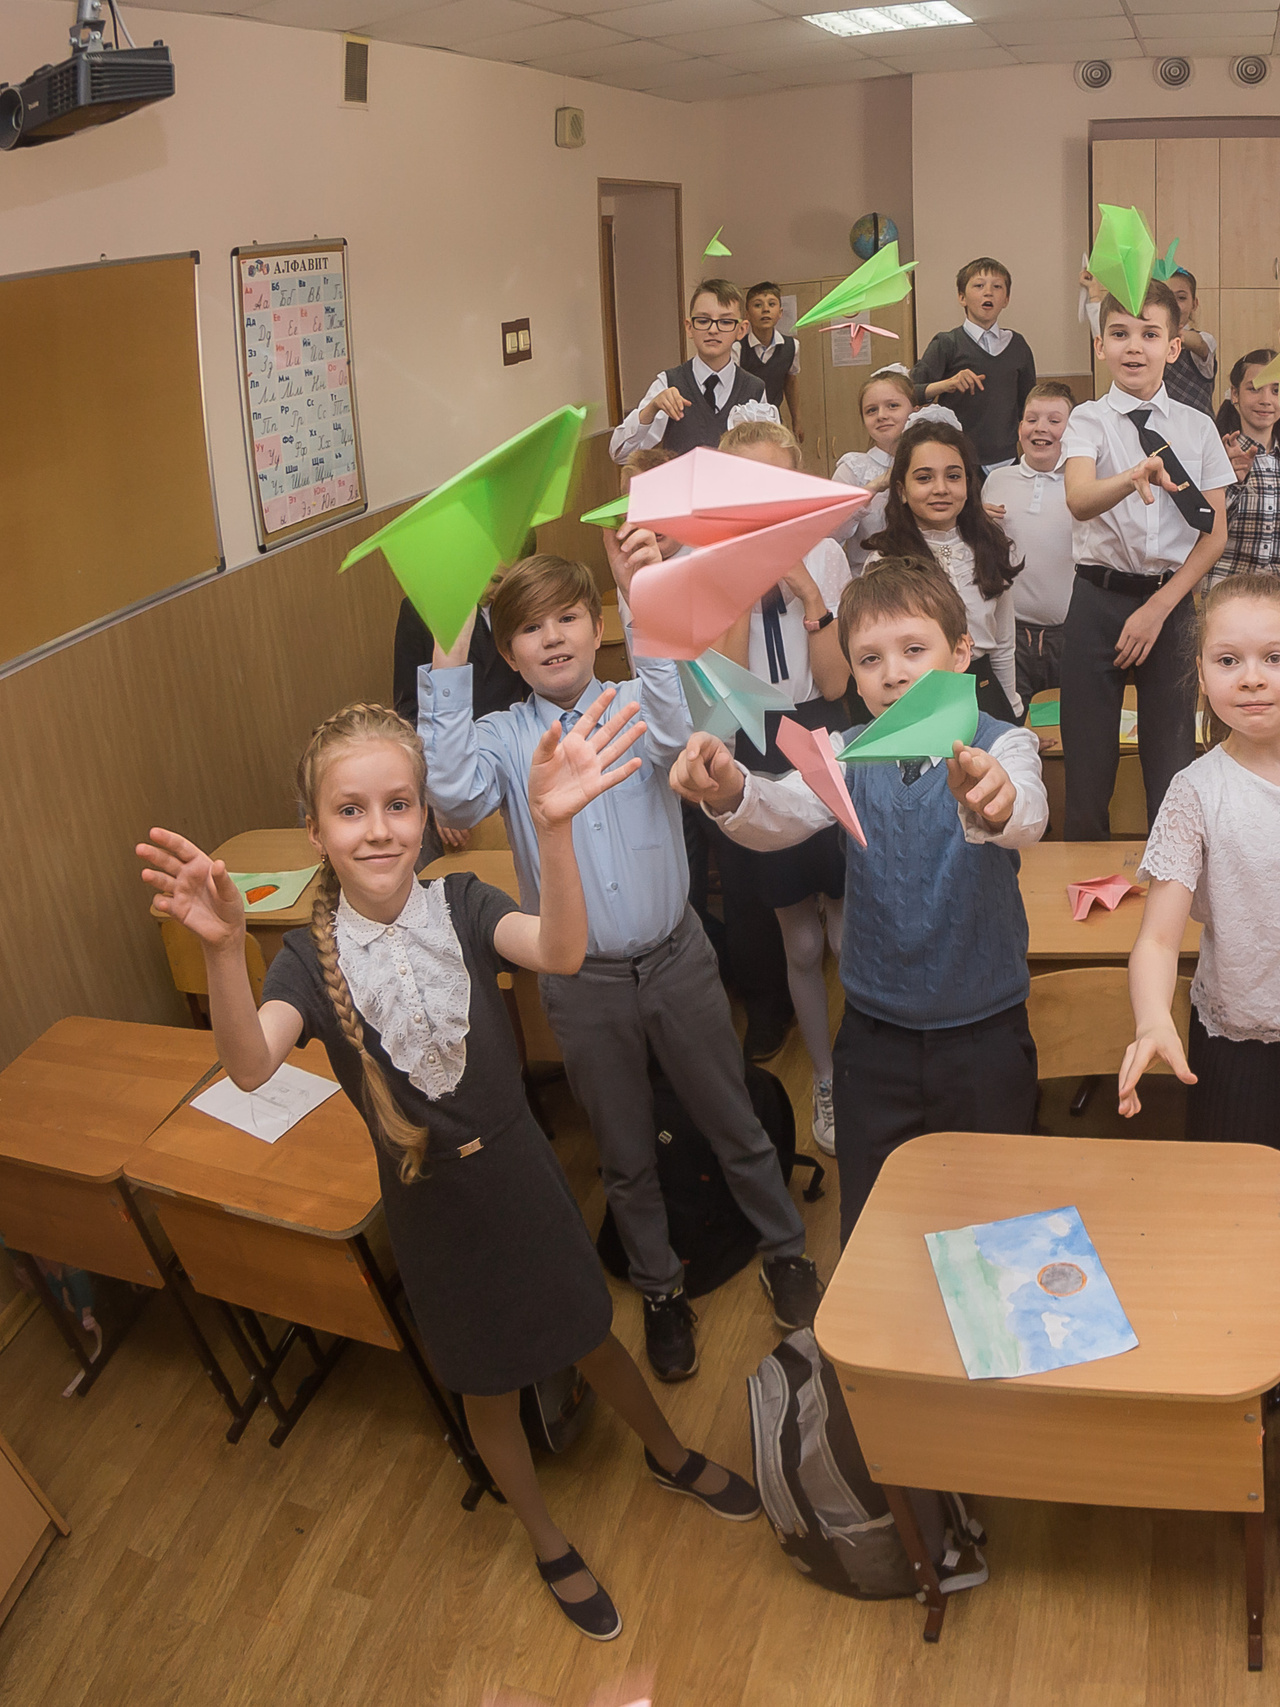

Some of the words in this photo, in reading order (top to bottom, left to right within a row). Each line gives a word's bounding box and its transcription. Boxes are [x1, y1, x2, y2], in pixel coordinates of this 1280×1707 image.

[274, 258, 328, 274] АЛФАВИТ
[272, 282, 280, 291] Бб
[253, 294, 269, 310] Аа
[280, 289, 296, 306] Бб
[308, 286, 320, 302] Вв
[288, 320, 297, 336] Ее
[261, 355, 272, 378] Зз
[286, 351, 300, 367] Ии
[258, 387, 276, 404] Лл
[281, 381, 303, 399] Мм
[312, 375, 326, 392] Нн
[281, 406, 289, 414] Рр
[261, 417, 278, 435] Пп
[291, 410, 304, 433] Рр
[318, 404, 326, 419] Сс
[282, 435, 294, 444] Фф
